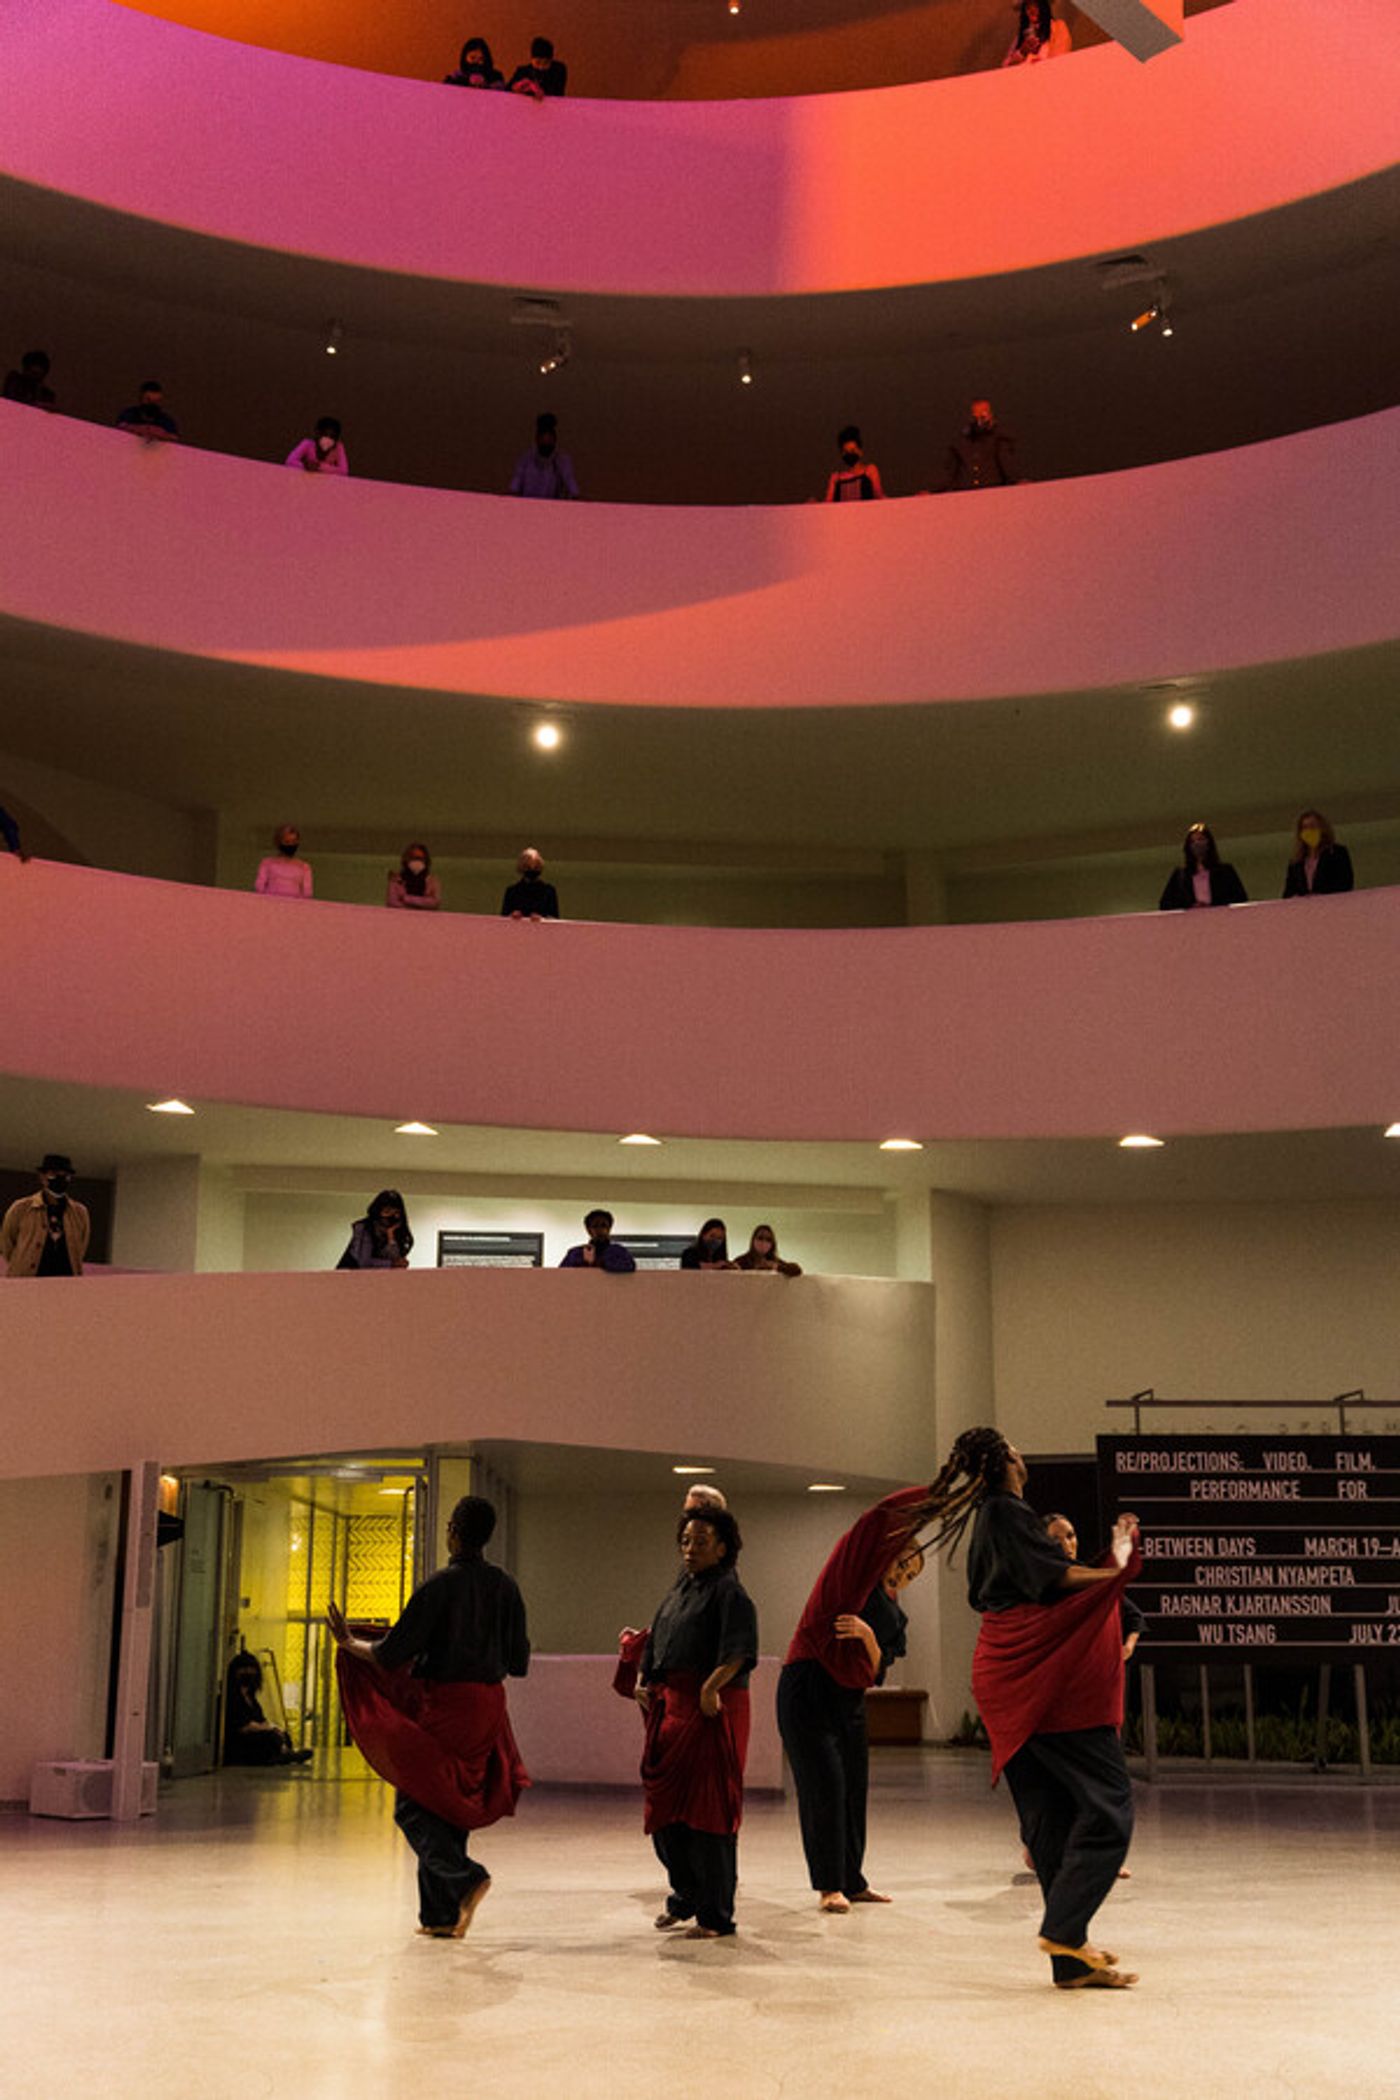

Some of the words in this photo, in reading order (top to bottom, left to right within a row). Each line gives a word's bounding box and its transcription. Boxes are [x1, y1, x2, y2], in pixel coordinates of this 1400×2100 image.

[1190, 1480, 1300, 1500] PERFORMANCE
[1337, 1480, 1367, 1500] FOR
[1218, 1537, 1256, 1557] DAYS
[1304, 1537, 1357, 1557] MARCH
[1195, 1566, 1274, 1586] CHRISTIAN
[1278, 1566, 1355, 1586] NYAMPETA
[1161, 1595, 1222, 1615] RAGNAR
[1226, 1595, 1332, 1615] KJARTANSSON
[1198, 1624, 1224, 1644] WU
[1228, 1624, 1277, 1644] TSANG
[1349, 1624, 1384, 1644] JULY
